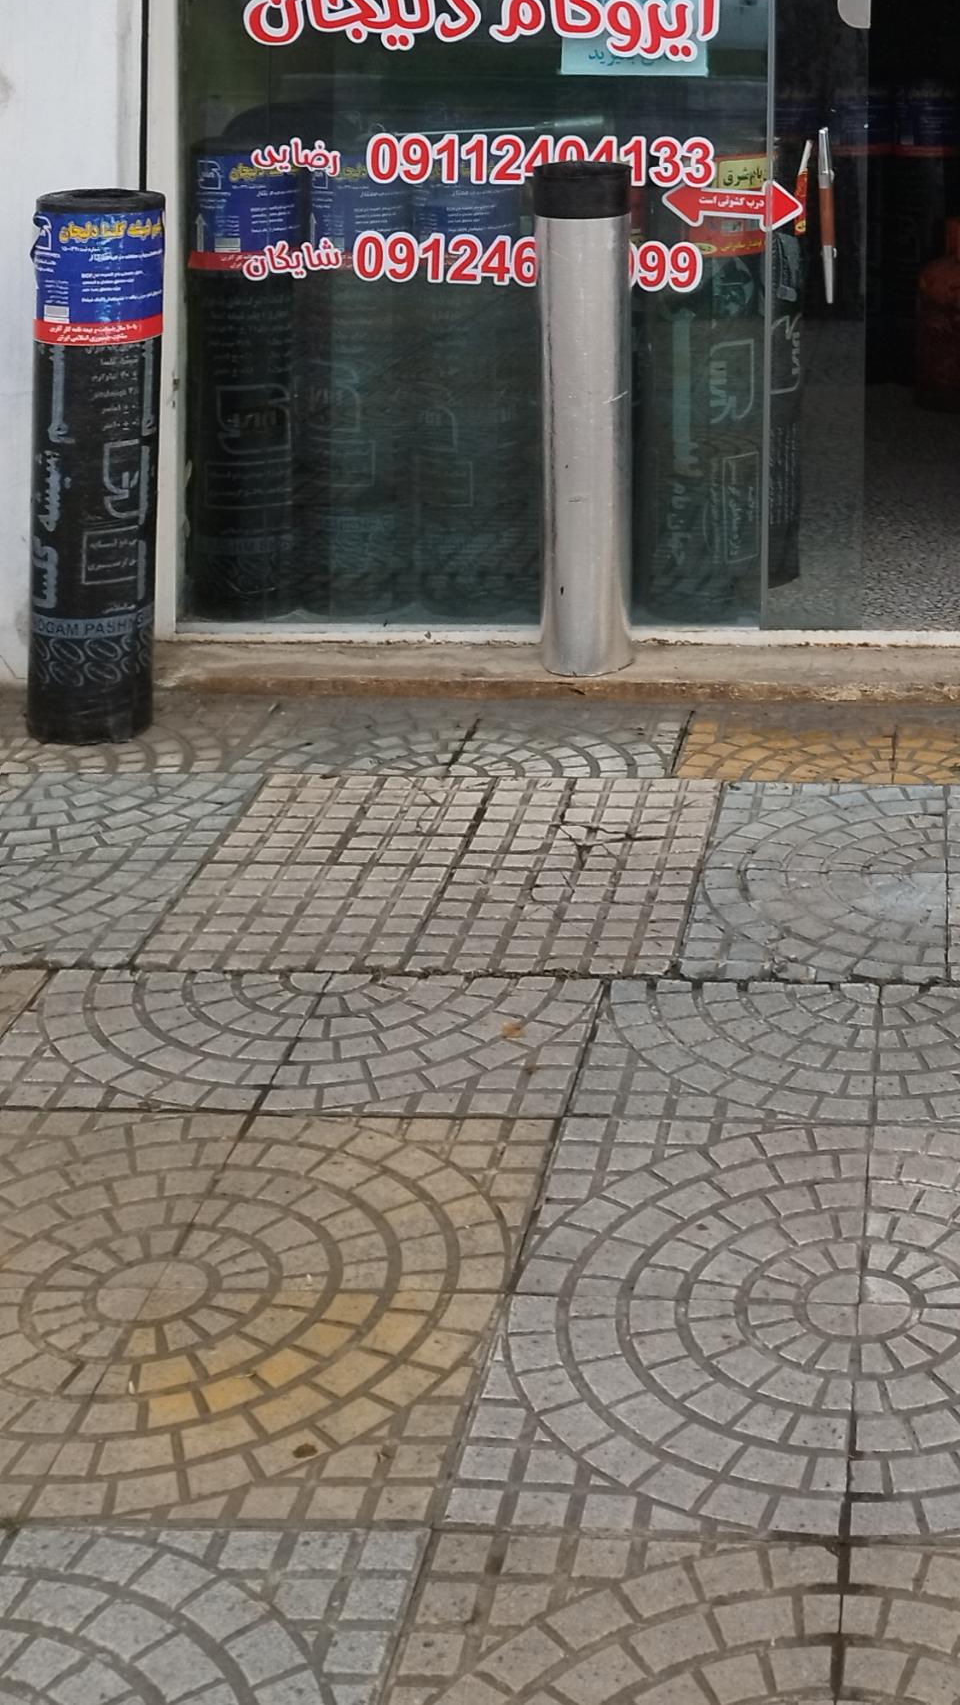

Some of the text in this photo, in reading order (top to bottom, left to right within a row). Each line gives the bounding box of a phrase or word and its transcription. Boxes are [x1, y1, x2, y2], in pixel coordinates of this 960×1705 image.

[251, 137, 340, 176] رضایی
[242, 236, 343, 282] شایگان
[352, 230, 703, 292] 09124699
